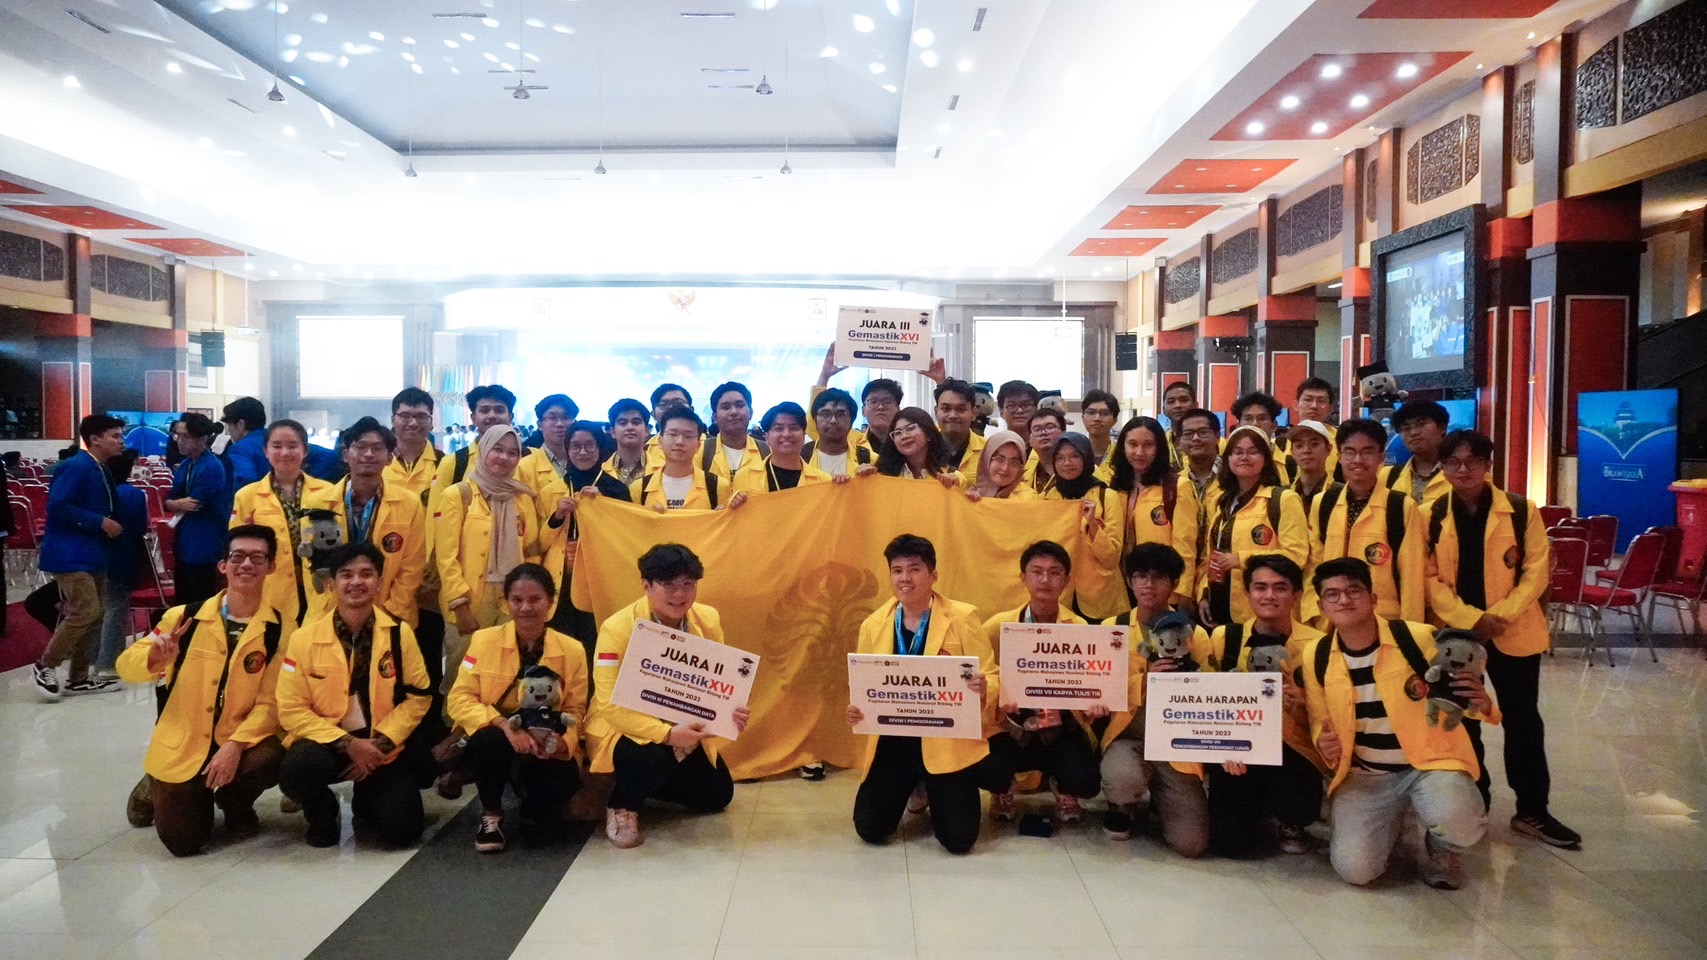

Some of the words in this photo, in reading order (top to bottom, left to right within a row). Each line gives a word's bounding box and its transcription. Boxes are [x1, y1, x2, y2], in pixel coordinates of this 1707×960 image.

[859, 320, 896, 330] JUARA
[900, 322, 910, 330] III
[848, 330, 919, 341] GemastikXVI
[1033, 642, 1082, 655] JUARA
[1087, 644, 1096, 655] II
[661, 647, 709, 672] JUARA
[714, 663, 724, 675] II
[1016, 658, 1112, 671] GemastikXVI
[641, 658, 735, 695] GemastikXVI
[882, 675, 932, 687] JUARA
[938, 677, 946, 687] II
[665, 686, 684, 697] TAHUN
[866, 688, 963, 701] GemastikXVI
[642, 692, 657, 701] DIVISI
[663, 699, 701, 714] PENAMBANGAN
[701, 710, 715, 718] DATA
[1169, 695, 1203, 704] JUARA
[1206, 696, 1258, 704] HARAPAN
[1163, 708, 1263, 721] GemastikXVI
